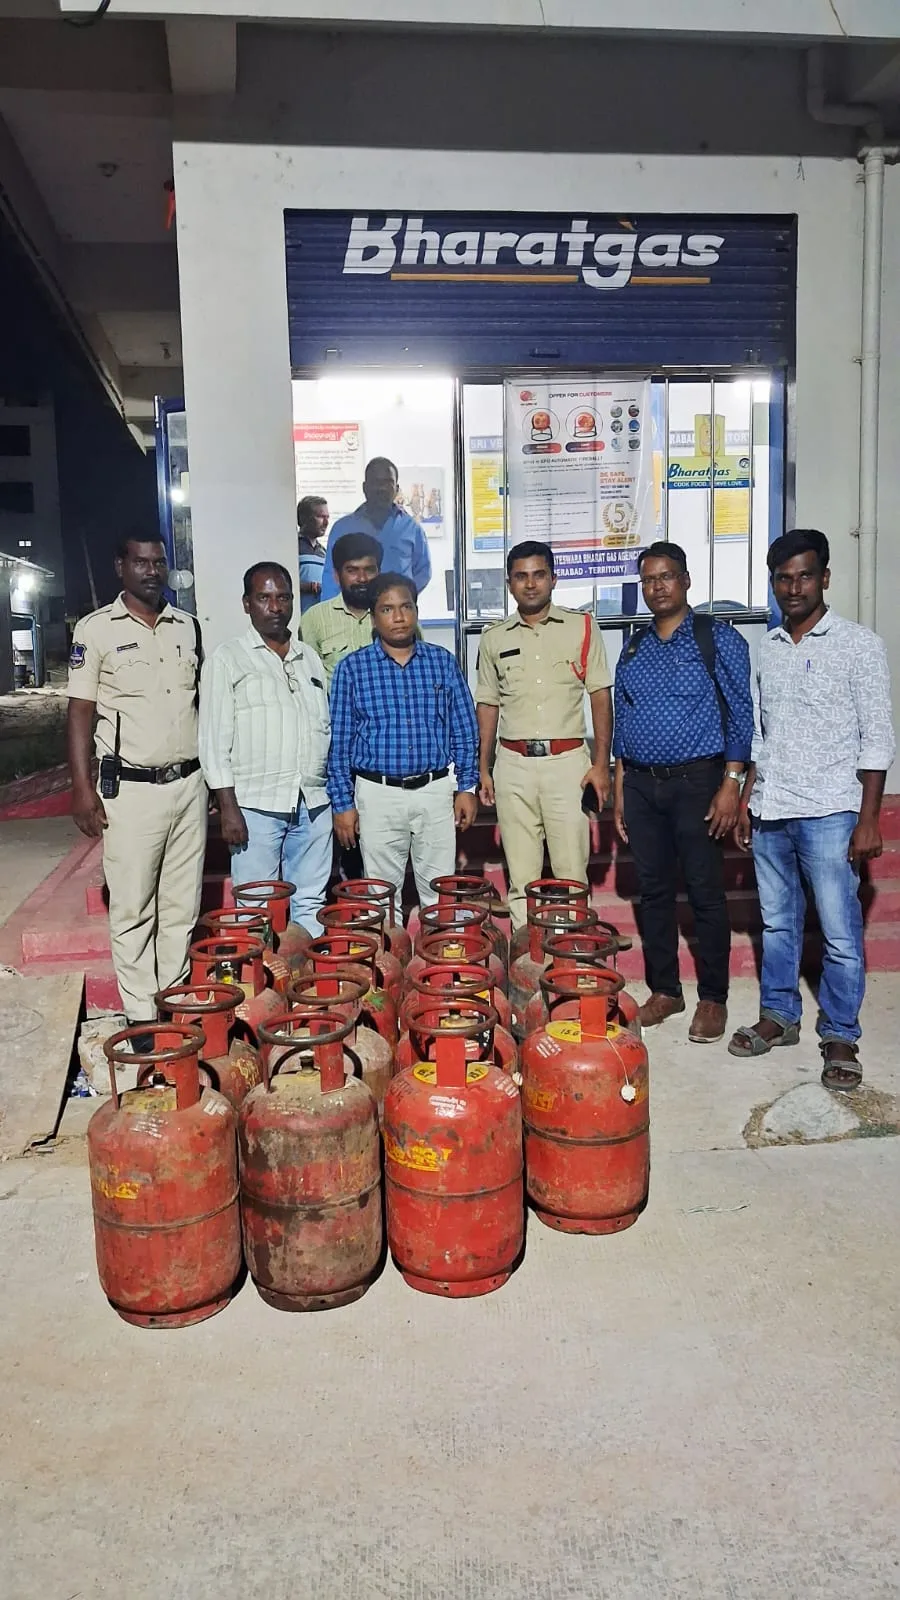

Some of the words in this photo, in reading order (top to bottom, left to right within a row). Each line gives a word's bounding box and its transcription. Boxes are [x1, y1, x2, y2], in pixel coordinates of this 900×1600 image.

[342, 215, 725, 290] Bharatgas
[668, 463, 731, 479] Bharatgas
[613, 503, 625, 523] 5
[606, 551, 617, 562] GAS
